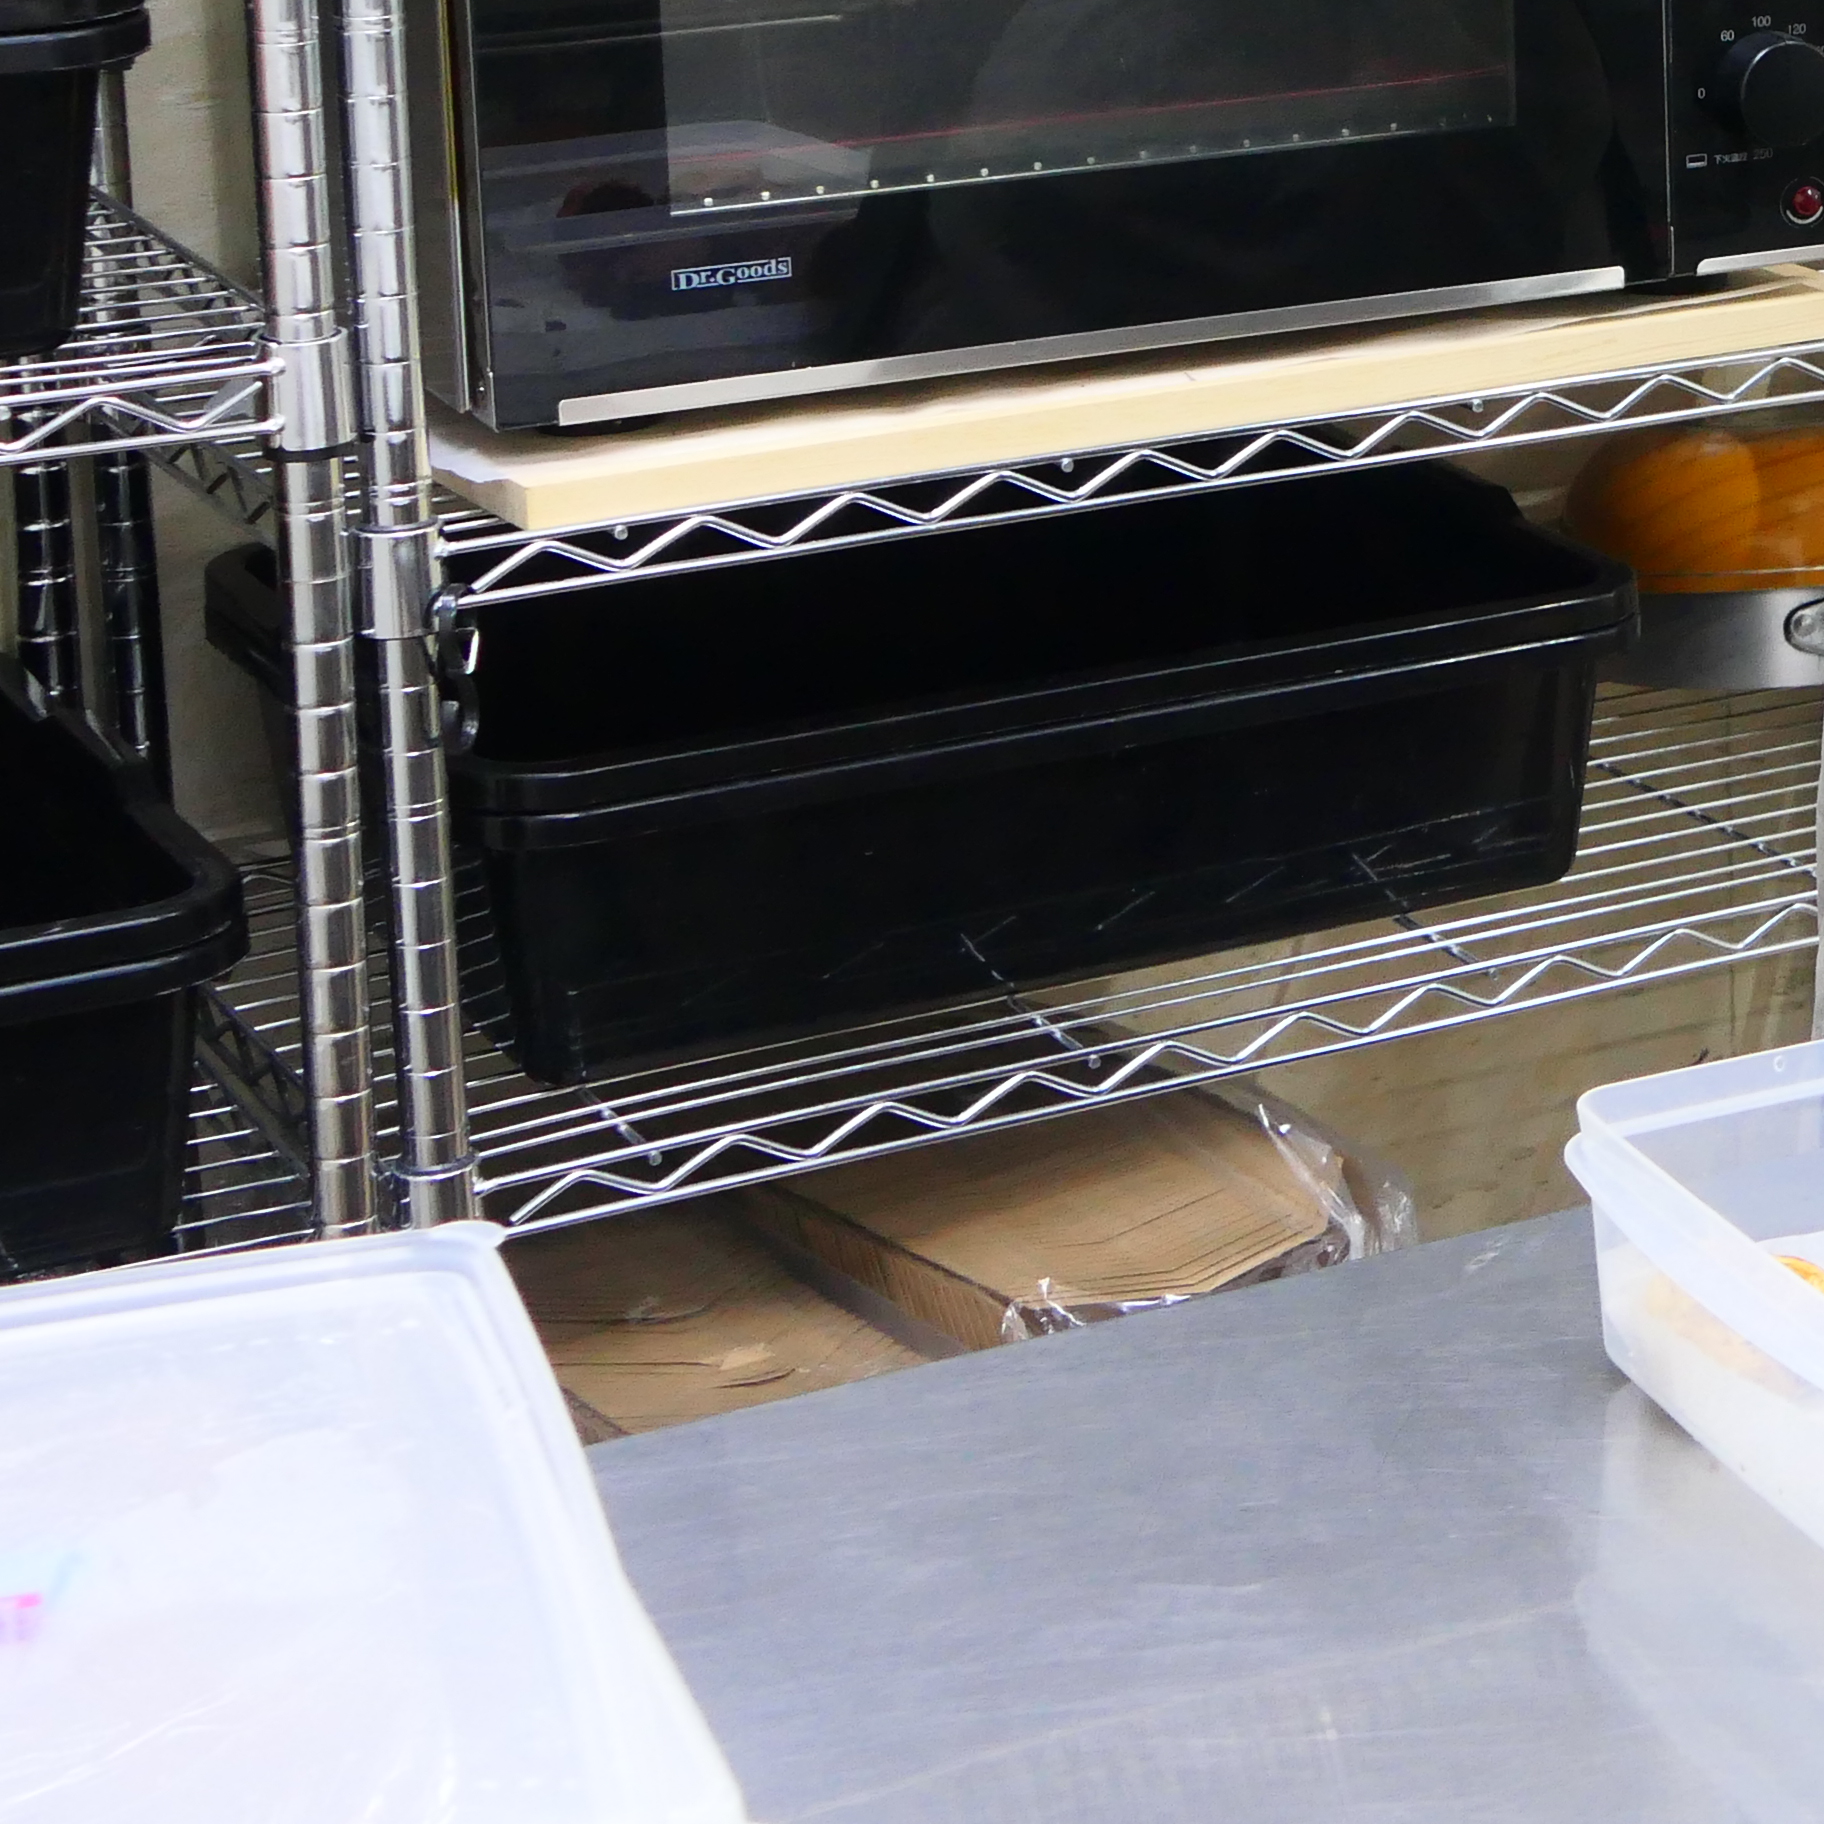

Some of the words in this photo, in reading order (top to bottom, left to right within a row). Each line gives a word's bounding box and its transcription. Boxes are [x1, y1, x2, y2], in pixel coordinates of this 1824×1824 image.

[1751, 15, 1771, 28] 100
[1720, 29, 1735, 42] 60
[1787, 23, 1806, 35] 120
[677, 259, 788, 290] Dr.Goods
